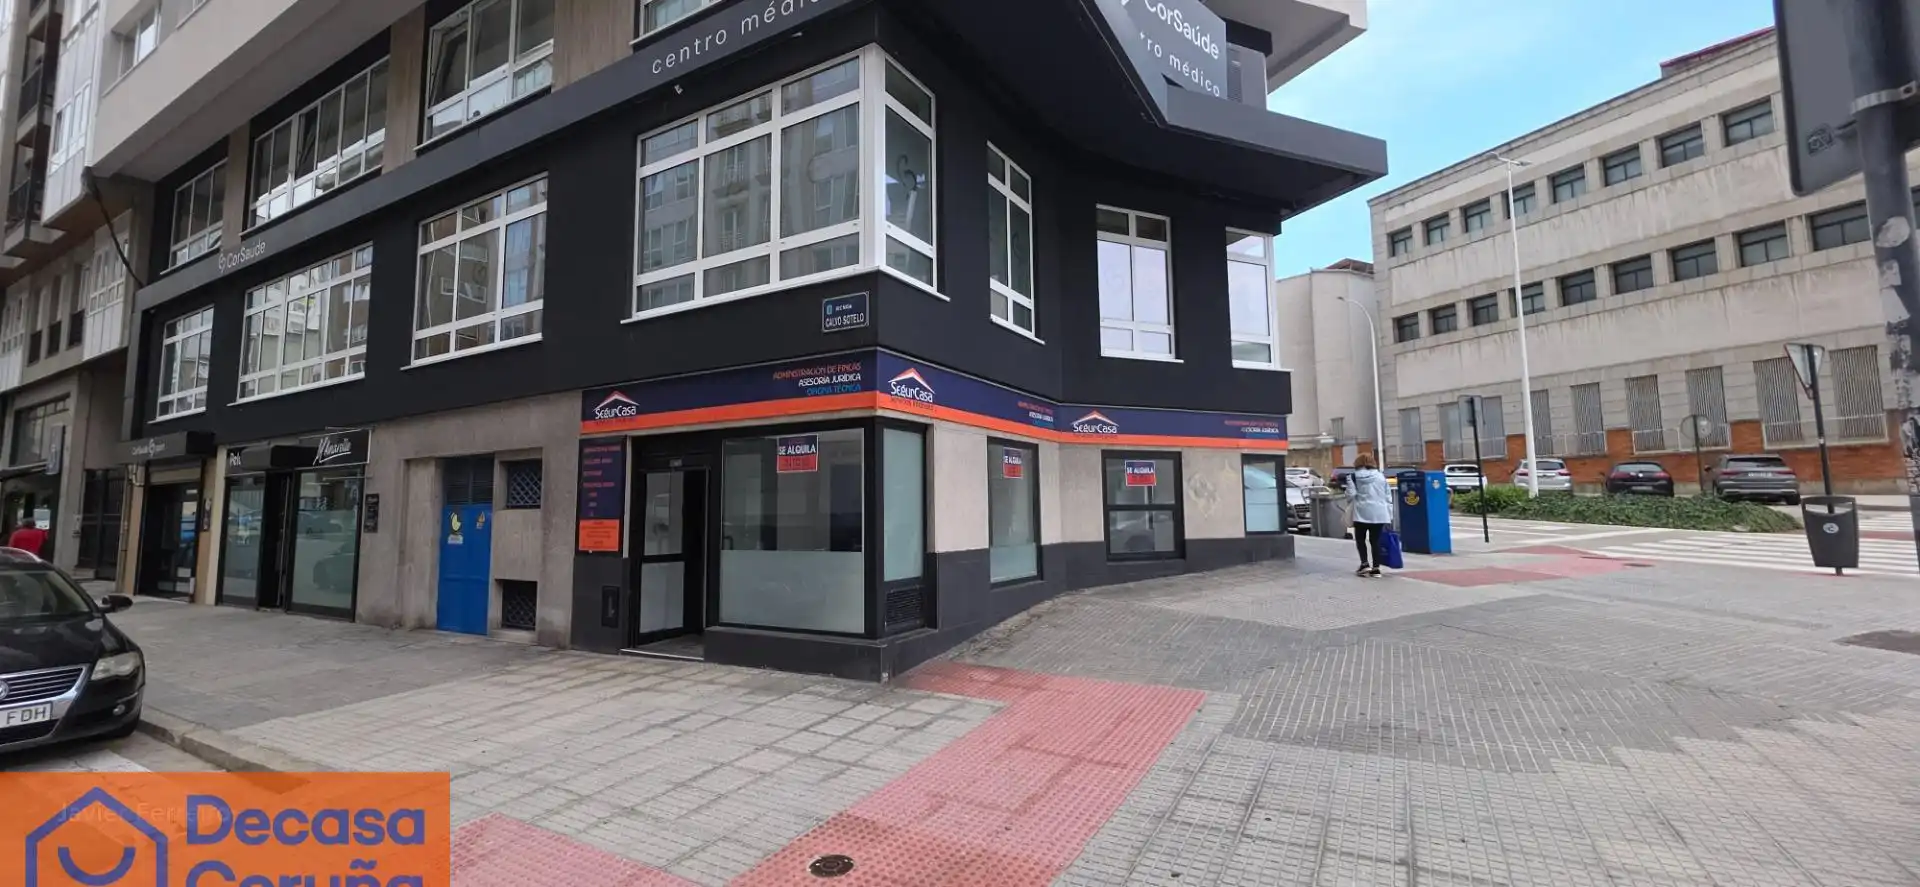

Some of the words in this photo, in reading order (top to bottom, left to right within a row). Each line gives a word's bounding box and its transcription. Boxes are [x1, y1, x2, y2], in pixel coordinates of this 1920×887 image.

[652, 29, 727, 74] centro
[1169, 54, 1220, 97] médico
[825, 316, 842, 328] CALVO
[842, 313, 864, 325] SOTELO
[831, 372, 862, 384] JURÍDICA
[787, 443, 817, 455] ALQUILA
[6, 706, 47, 725] FDH
